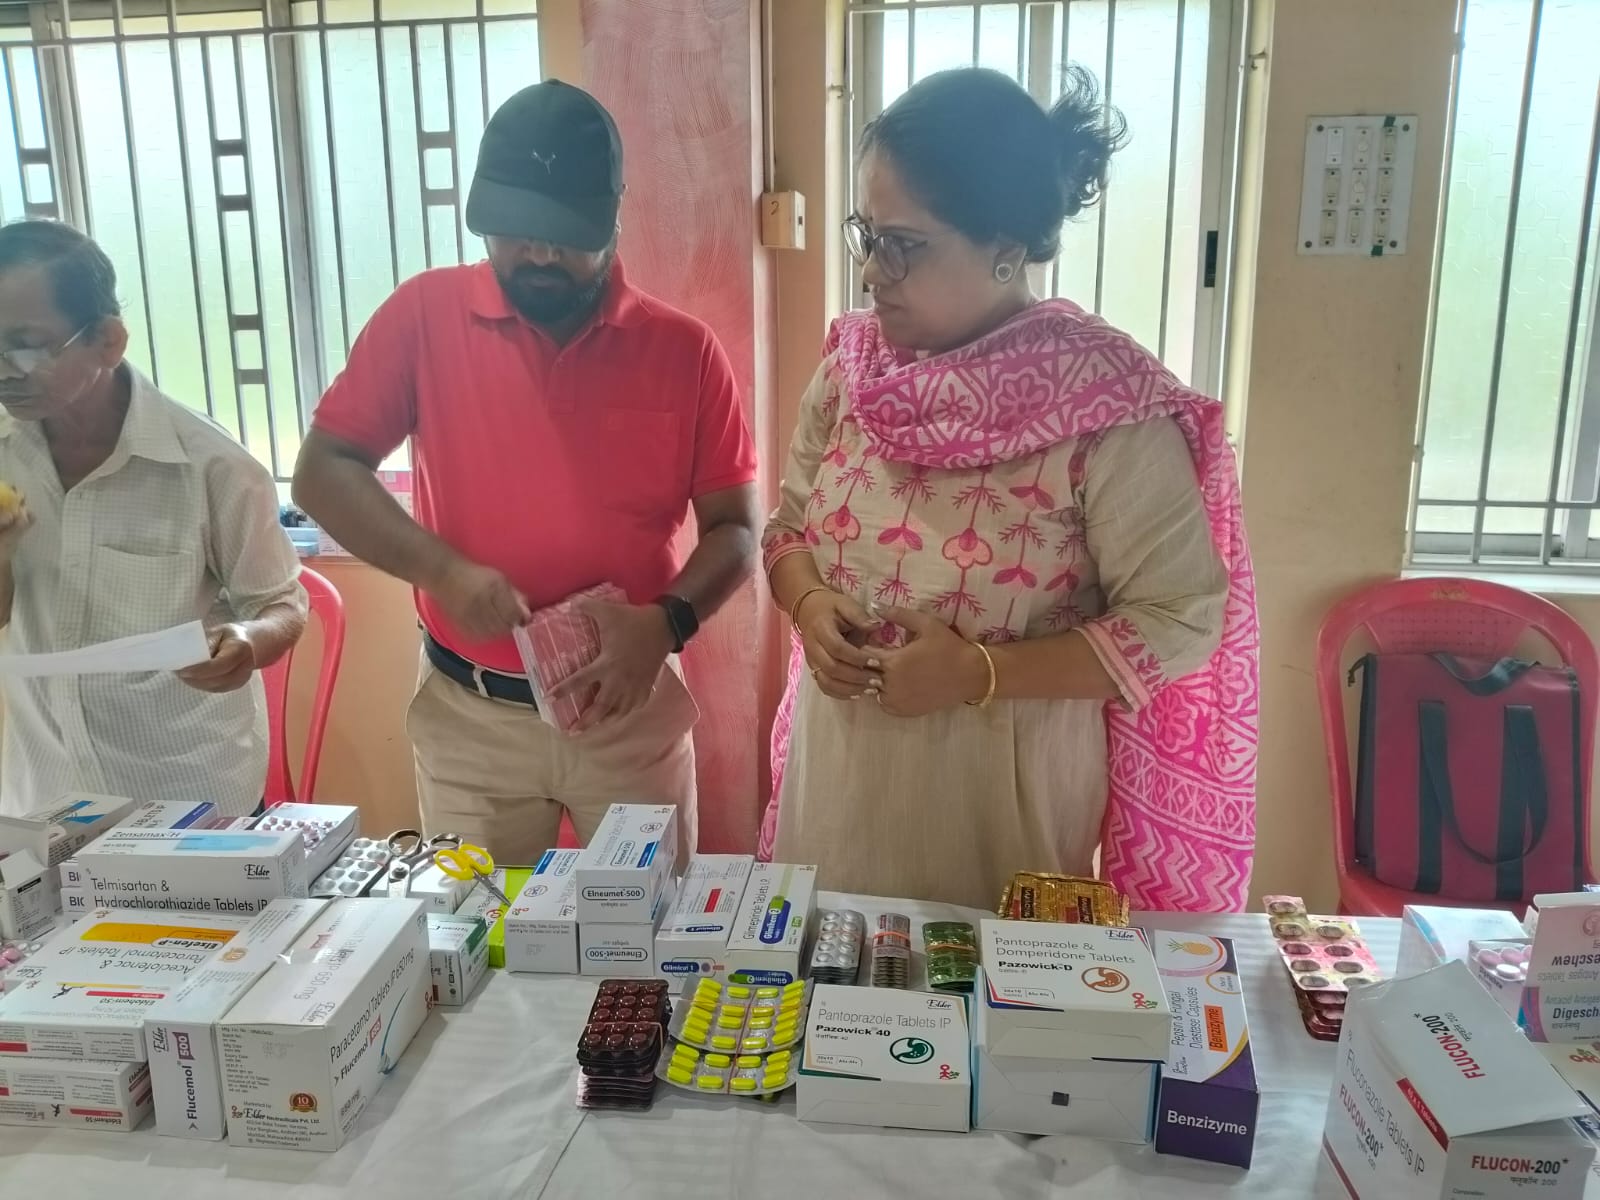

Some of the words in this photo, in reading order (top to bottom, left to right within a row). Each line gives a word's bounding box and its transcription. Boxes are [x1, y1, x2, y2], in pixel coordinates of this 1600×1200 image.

[244, 864, 270, 878] Elder
[91, 878, 158, 892] Telmisartan
[161, 880, 170, 892] &
[94, 896, 211, 912] Hydrochlorothiazide
[215, 898, 254, 912] Tablets
[995, 937, 1078, 950] Pantoprazole
[1083, 942, 1095, 951] &
[79, 946, 121, 958] Tablets
[126, 950, 206, 964] Paracetamol
[996, 948, 1086, 960] Domperidone
[1089, 952, 1136, 964] Tablets
[100, 960, 113, 970] &
[117, 960, 196, 974] Aceclofenac
[1551, 954, 1600, 968] eschew
[927, 998, 952, 1010] Elder
[1186, 986, 1202, 1017] Capsules
[818, 1008, 893, 1026] Pantoprazole
[896, 1015, 936, 1028] Tablets
[940, 1016, 952, 1030] IP
[1552, 1006, 1600, 1021] Digesch
[816, 1024, 872, 1035] Pazowick
[875, 1029, 890, 1037] 40
[1188, 1018, 1203, 1049] Diastase
[1208, 1008, 1224, 1049] Benzizyme
[178, 1036, 190, 1057] 500
[340, 1038, 370, 1080] Flucemol
[186, 1064, 198, 1120] Flucemol
[297, 1096, 309, 1105] 10
[1346, 1048, 1391, 1118] Fluconazole
[1387, 1111, 1414, 1166] Tablets
[1414, 1154, 1426, 1176] IP
[1166, 1110, 1248, 1136] Benzizyme
